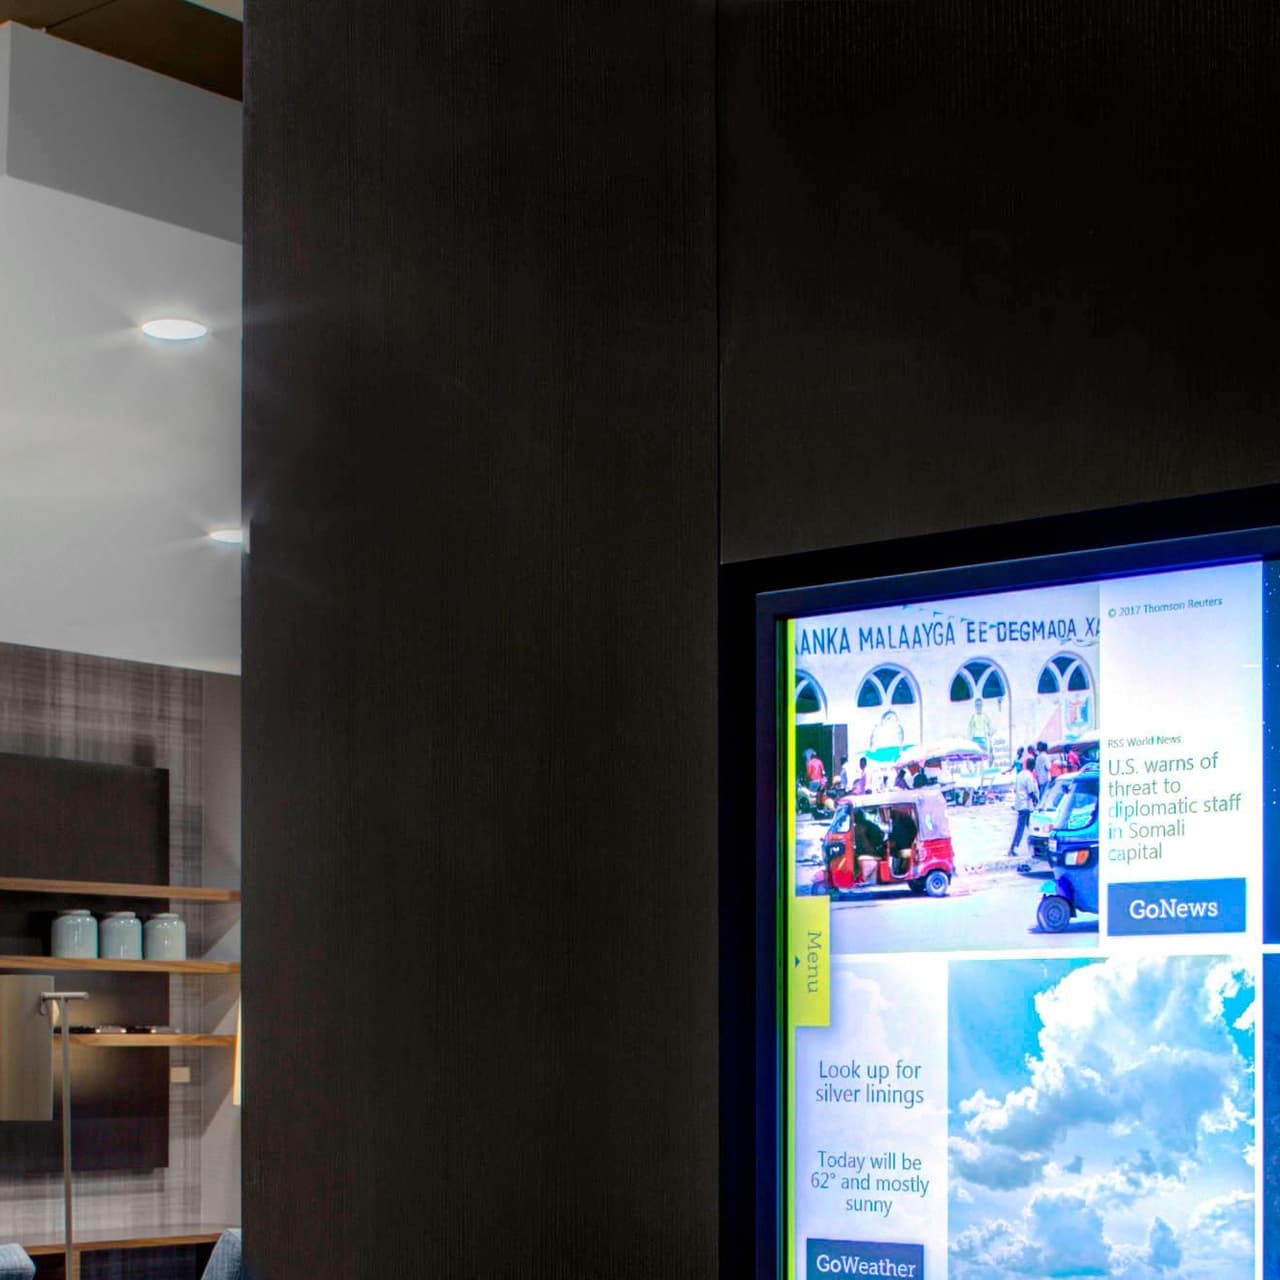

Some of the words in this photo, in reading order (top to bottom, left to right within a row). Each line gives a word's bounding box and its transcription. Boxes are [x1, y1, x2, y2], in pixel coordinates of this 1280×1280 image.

[1119, 605, 1141, 617] 2017
[1143, 602, 1185, 614] Thomson
[1187, 598, 1223, 609] Reuters
[795, 627, 851, 655] ANKA
[858, 620, 955, 652] MALAAYGA
[966, 621, 988, 643] EE
[997, 618, 1076, 642] DEGMADA
[1108, 739, 1124, 749] RSS
[1127, 736, 1154, 747] World
[1156, 735, 1181, 745] News
[1108, 758, 1138, 776] U.S.
[1144, 757, 1194, 773] warns
[1200, 751, 1218, 770] of
[1108, 779, 1157, 797] threat
[1163, 778, 1180, 794] to
[1108, 796, 1198, 821] diplomatic
[1203, 792, 1242, 812] staff
[1108, 822, 1122, 840] in
[1128, 818, 1185, 839] Somali
[1108, 841, 1162, 865] capital
[1129, 899, 1219, 919] GoNews
[807, 931, 822, 993] Menu
[819, 1059, 861, 1079] Look
[867, 1064, 890, 1084] up
[896, 1059, 922, 1079] for
[815, 1083, 860, 1103] silver
[866, 1084, 924, 1109] linings
[817, 1150, 865, 1173] Today
[870, 1152, 896, 1170] will
[902, 1153, 922, 1171] be
[810, 1171, 836, 1189] 62°
[841, 1173, 870, 1191] and
[876, 1176, 929, 1197] mostly
[845, 1198, 892, 1218] sunny
[816, 1254, 916, 1278] GoWeather
